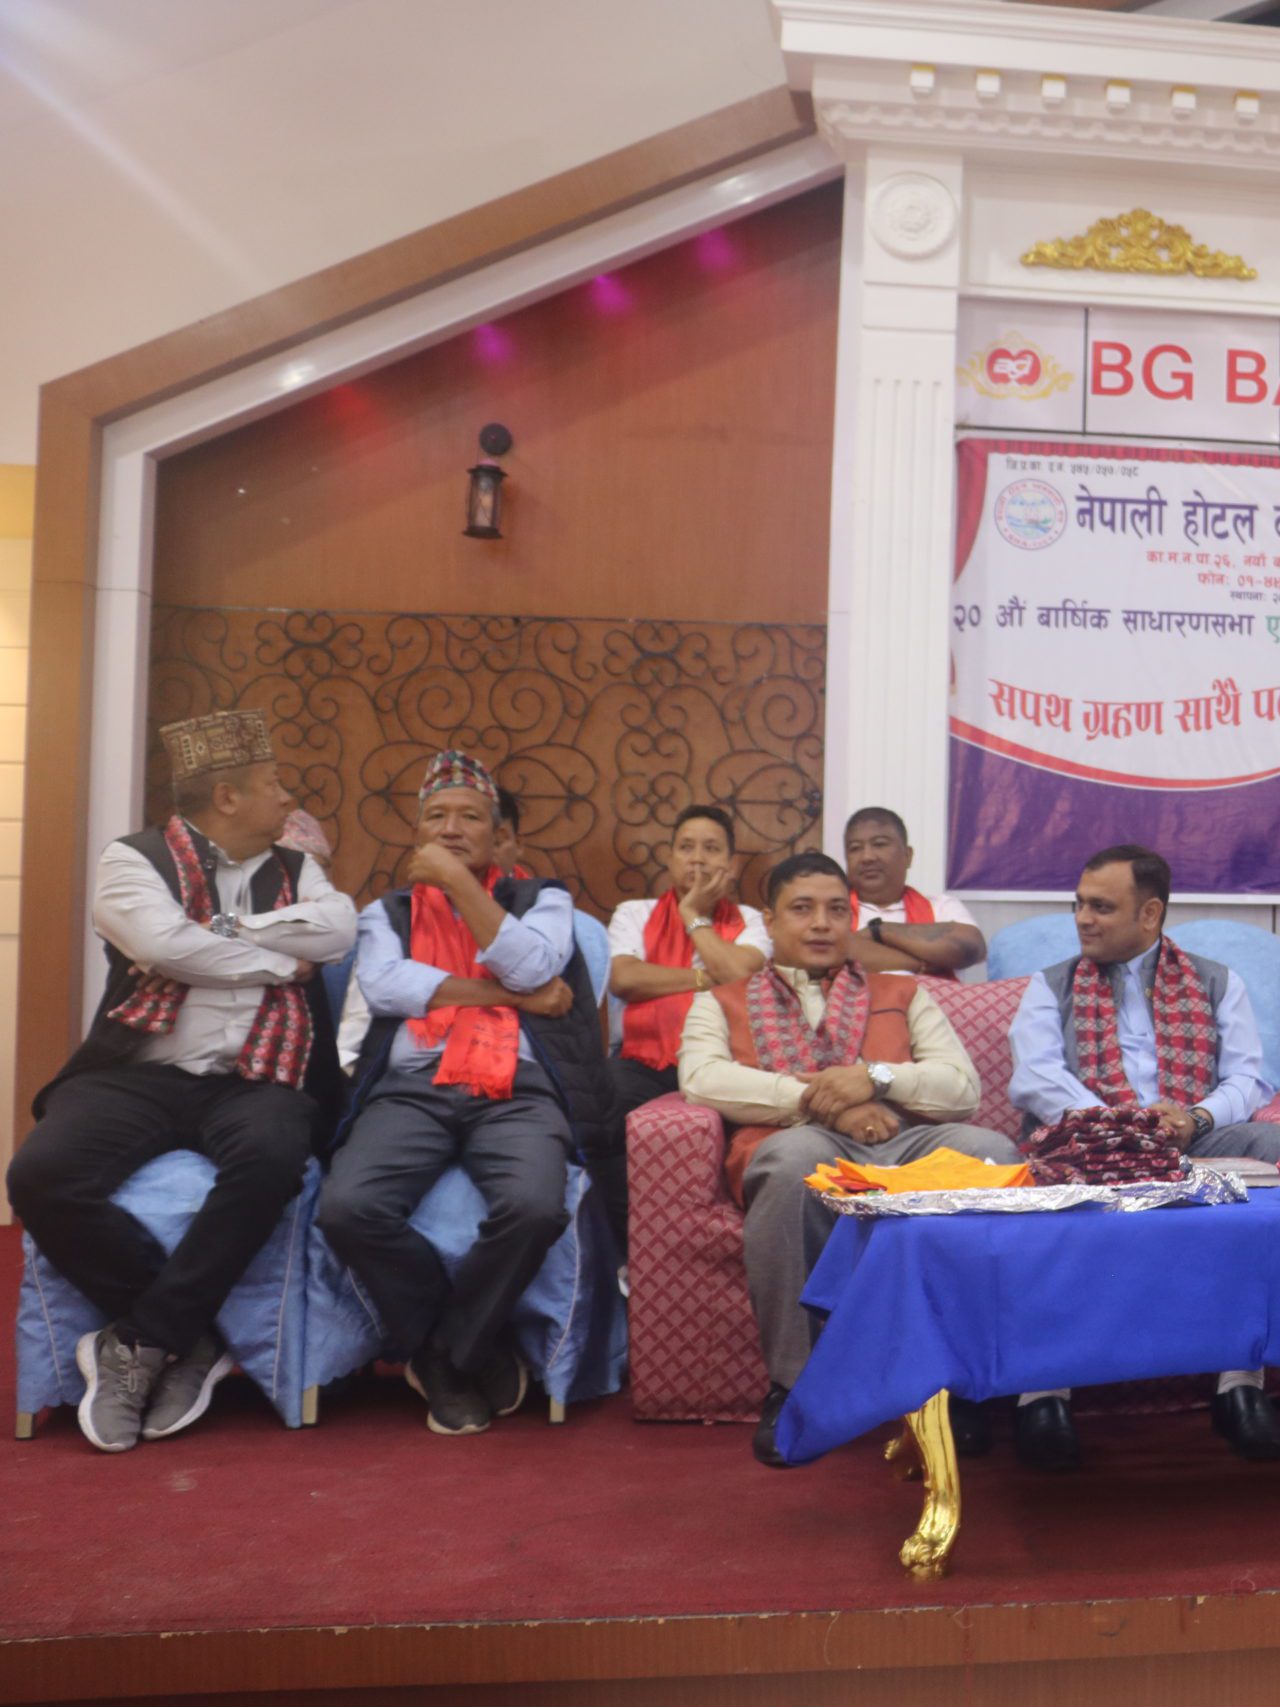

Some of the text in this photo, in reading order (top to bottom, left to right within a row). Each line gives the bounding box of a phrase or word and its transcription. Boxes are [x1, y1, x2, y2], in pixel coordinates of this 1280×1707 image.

[1090, 340, 1194, 401] BG
[1074, 484, 1168, 540] नेपाली
[1182, 490, 1259, 546] होटल
[952, 603, 982, 632] २०
[1121, 609, 1256, 638] साधारणसभा
[988, 677, 1073, 732] सपथ
[1082, 700, 1164, 740] ग्रहण
[1174, 677, 1243, 733] साथै
